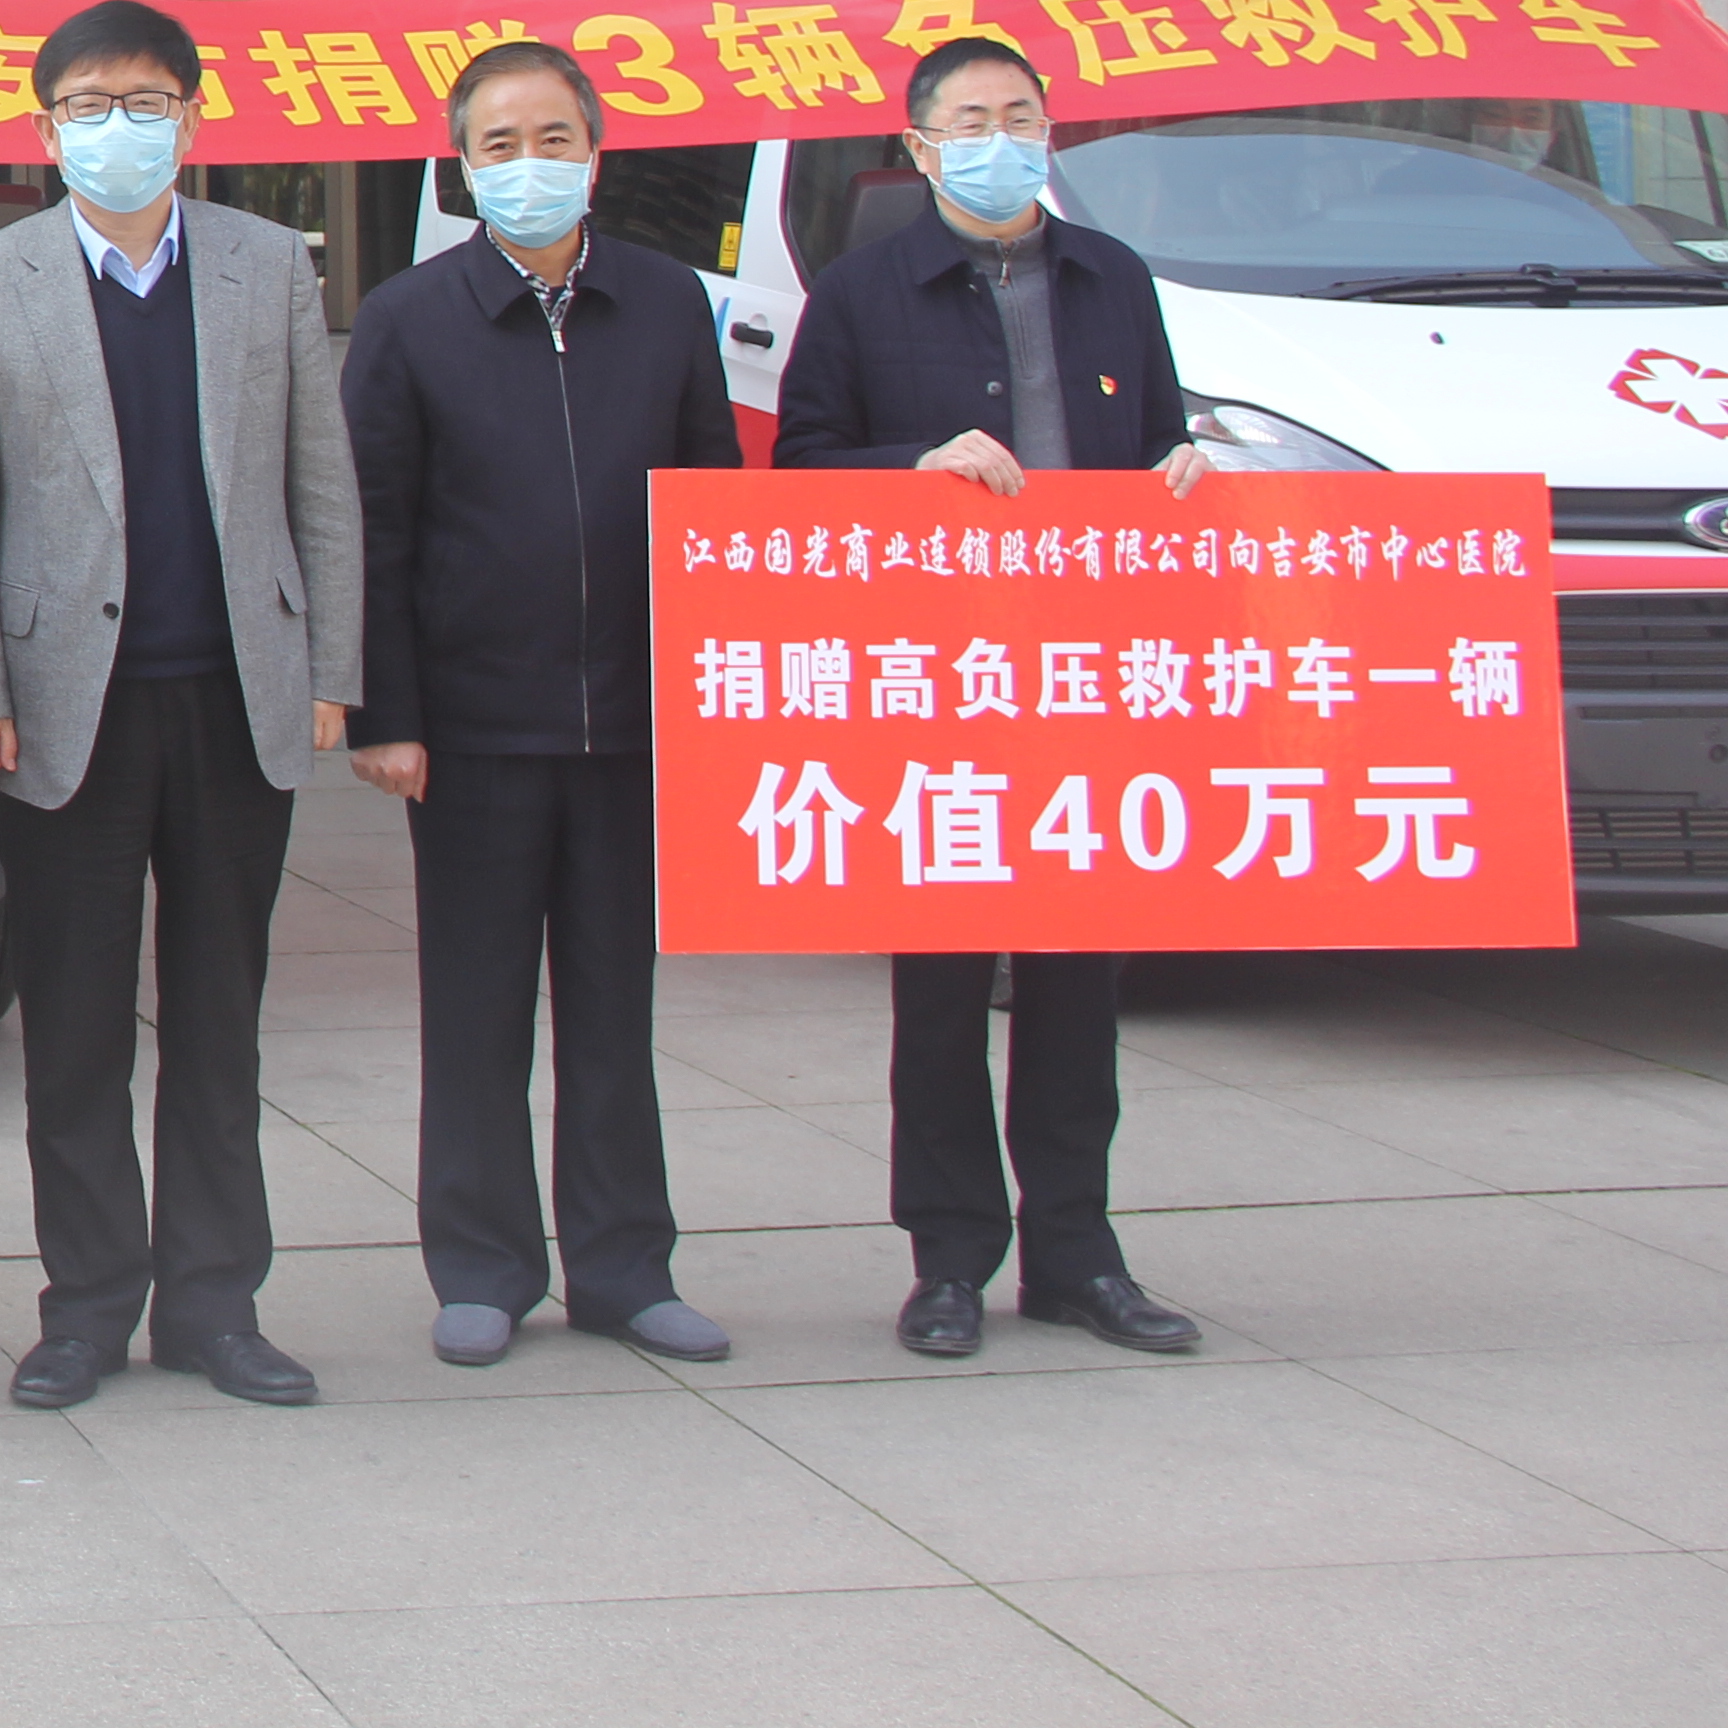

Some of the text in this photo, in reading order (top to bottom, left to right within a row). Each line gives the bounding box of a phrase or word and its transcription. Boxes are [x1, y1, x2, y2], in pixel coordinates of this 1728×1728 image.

[684, 524, 1525, 581] 江西国光商业连锁股份有限公司向吉安市中心医院
[694, 637, 1518, 719] 捐赠高负压救护车一辆
[738, 761, 1474, 885] 价值40万元
